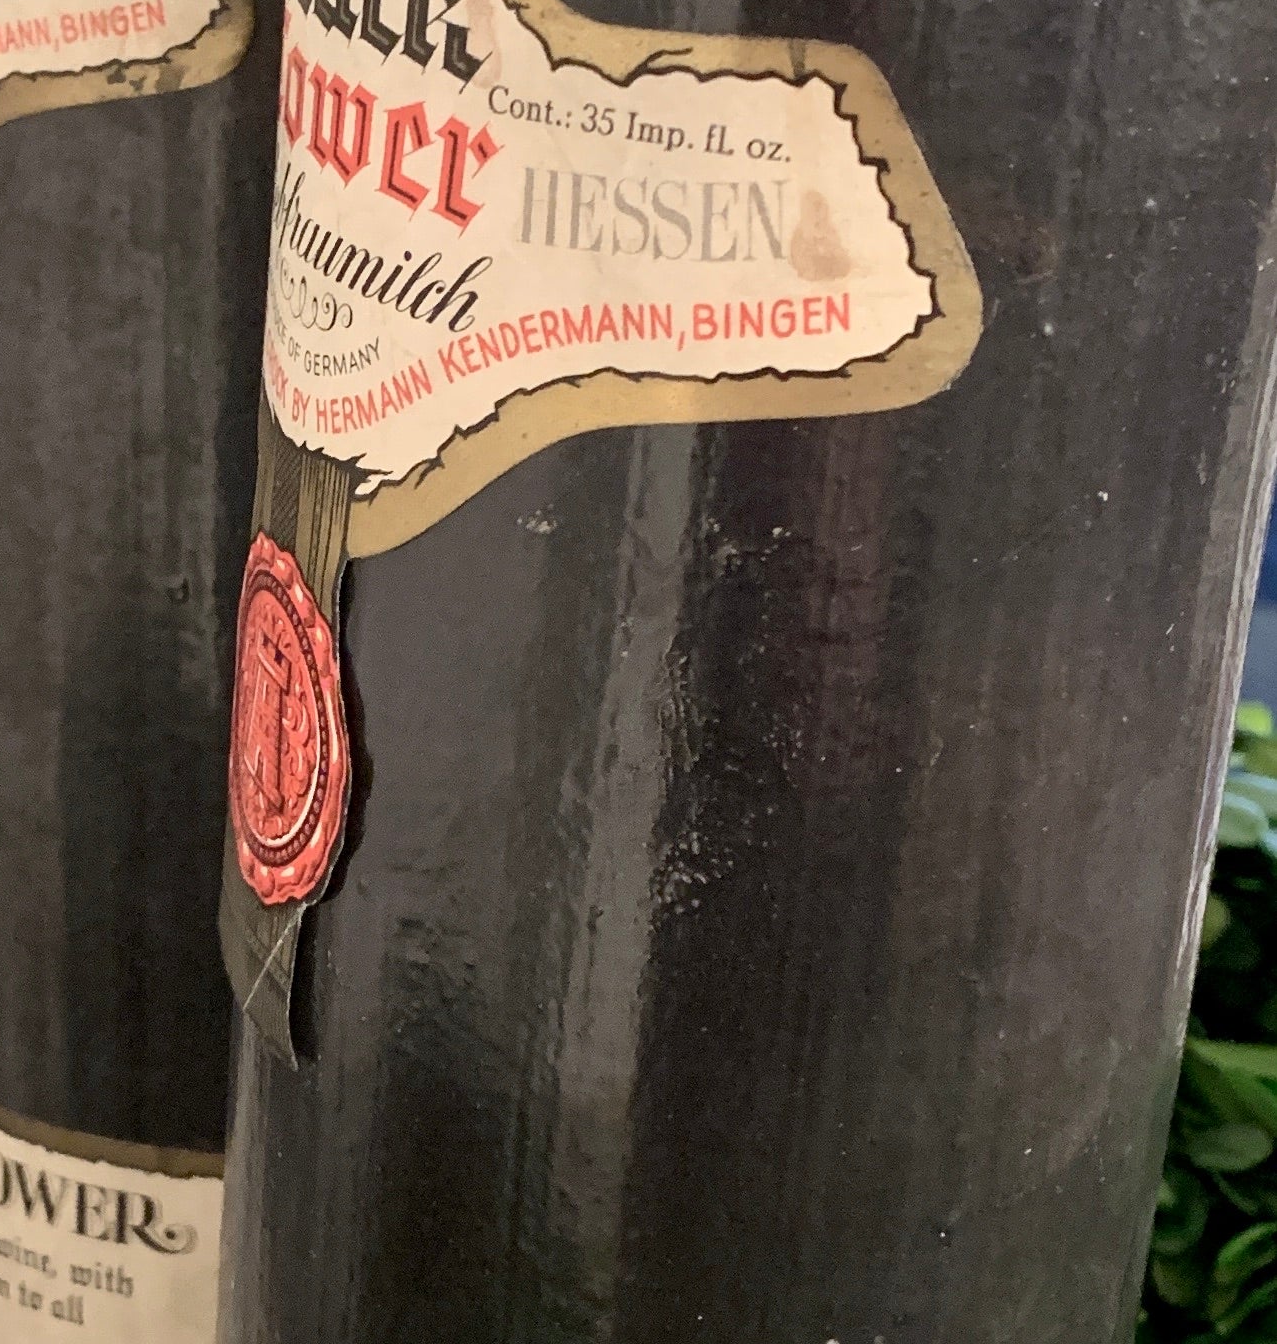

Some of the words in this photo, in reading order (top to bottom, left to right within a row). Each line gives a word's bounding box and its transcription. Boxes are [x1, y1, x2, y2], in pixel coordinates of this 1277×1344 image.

[283, 6, 505, 239] ower
[488, 85, 572, 131] Cont.:
[579, 102, 616, 137] 35
[625, 111, 694, 154] Imp.
[746, 136, 793, 165] oz.
[519, 166, 793, 266] HESSEN
[291, 386, 311, 429] BY
[315, 358, 433, 436] HERMANN
[690, 292, 851, 344] BINGEN
[303, 336, 381, 378] GERMANY
[69, 1261, 135, 1299] with
